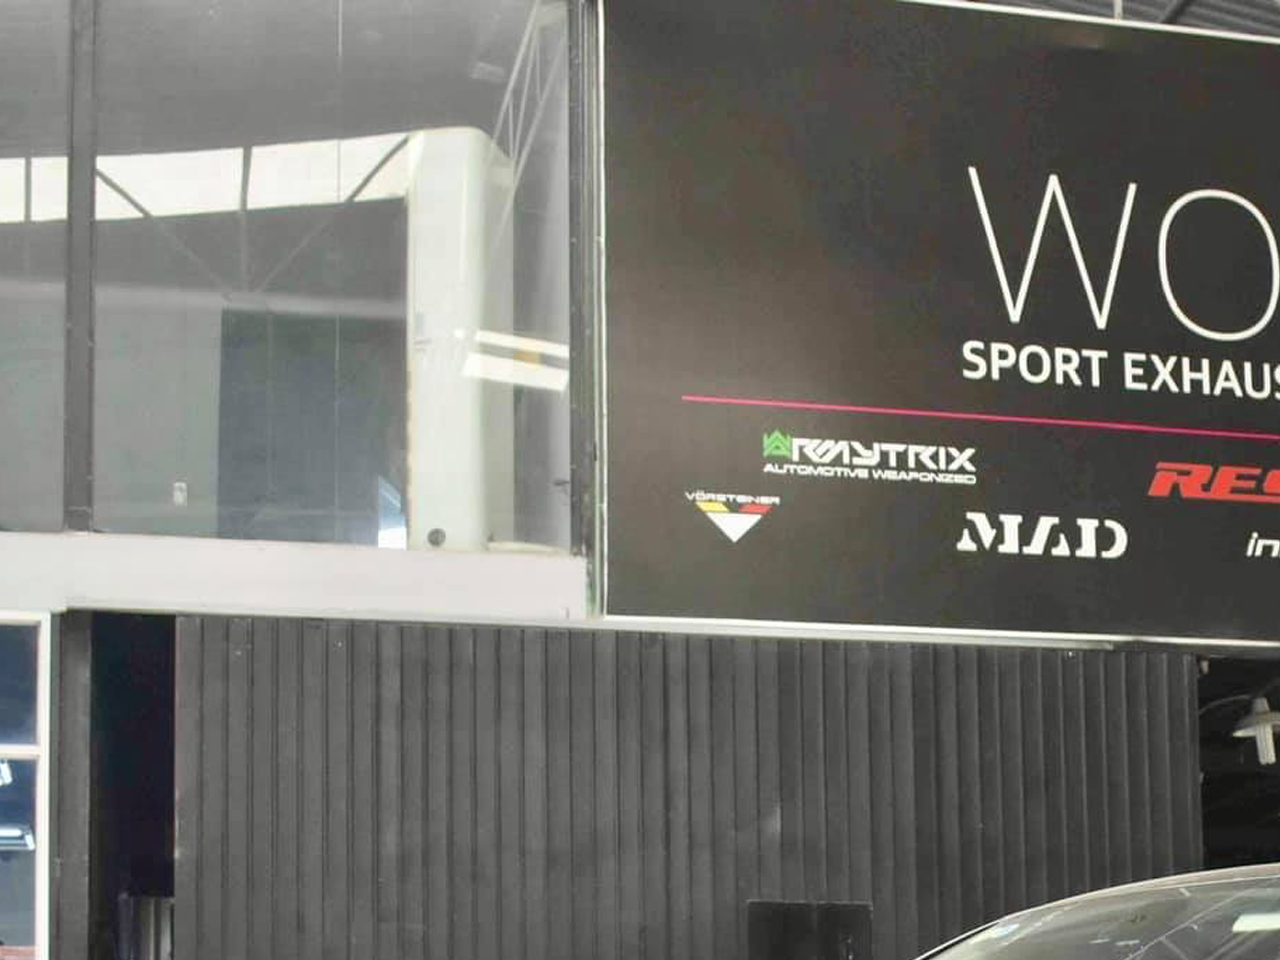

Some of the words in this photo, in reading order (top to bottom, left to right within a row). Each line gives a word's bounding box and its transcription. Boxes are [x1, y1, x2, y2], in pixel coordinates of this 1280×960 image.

[962, 340, 1108, 389] SPORT
[763, 463, 870, 480] AUTOMOTIVE
[872, 469, 977, 485] WEAPONIZED
[956, 511, 1129, 559] MAD
